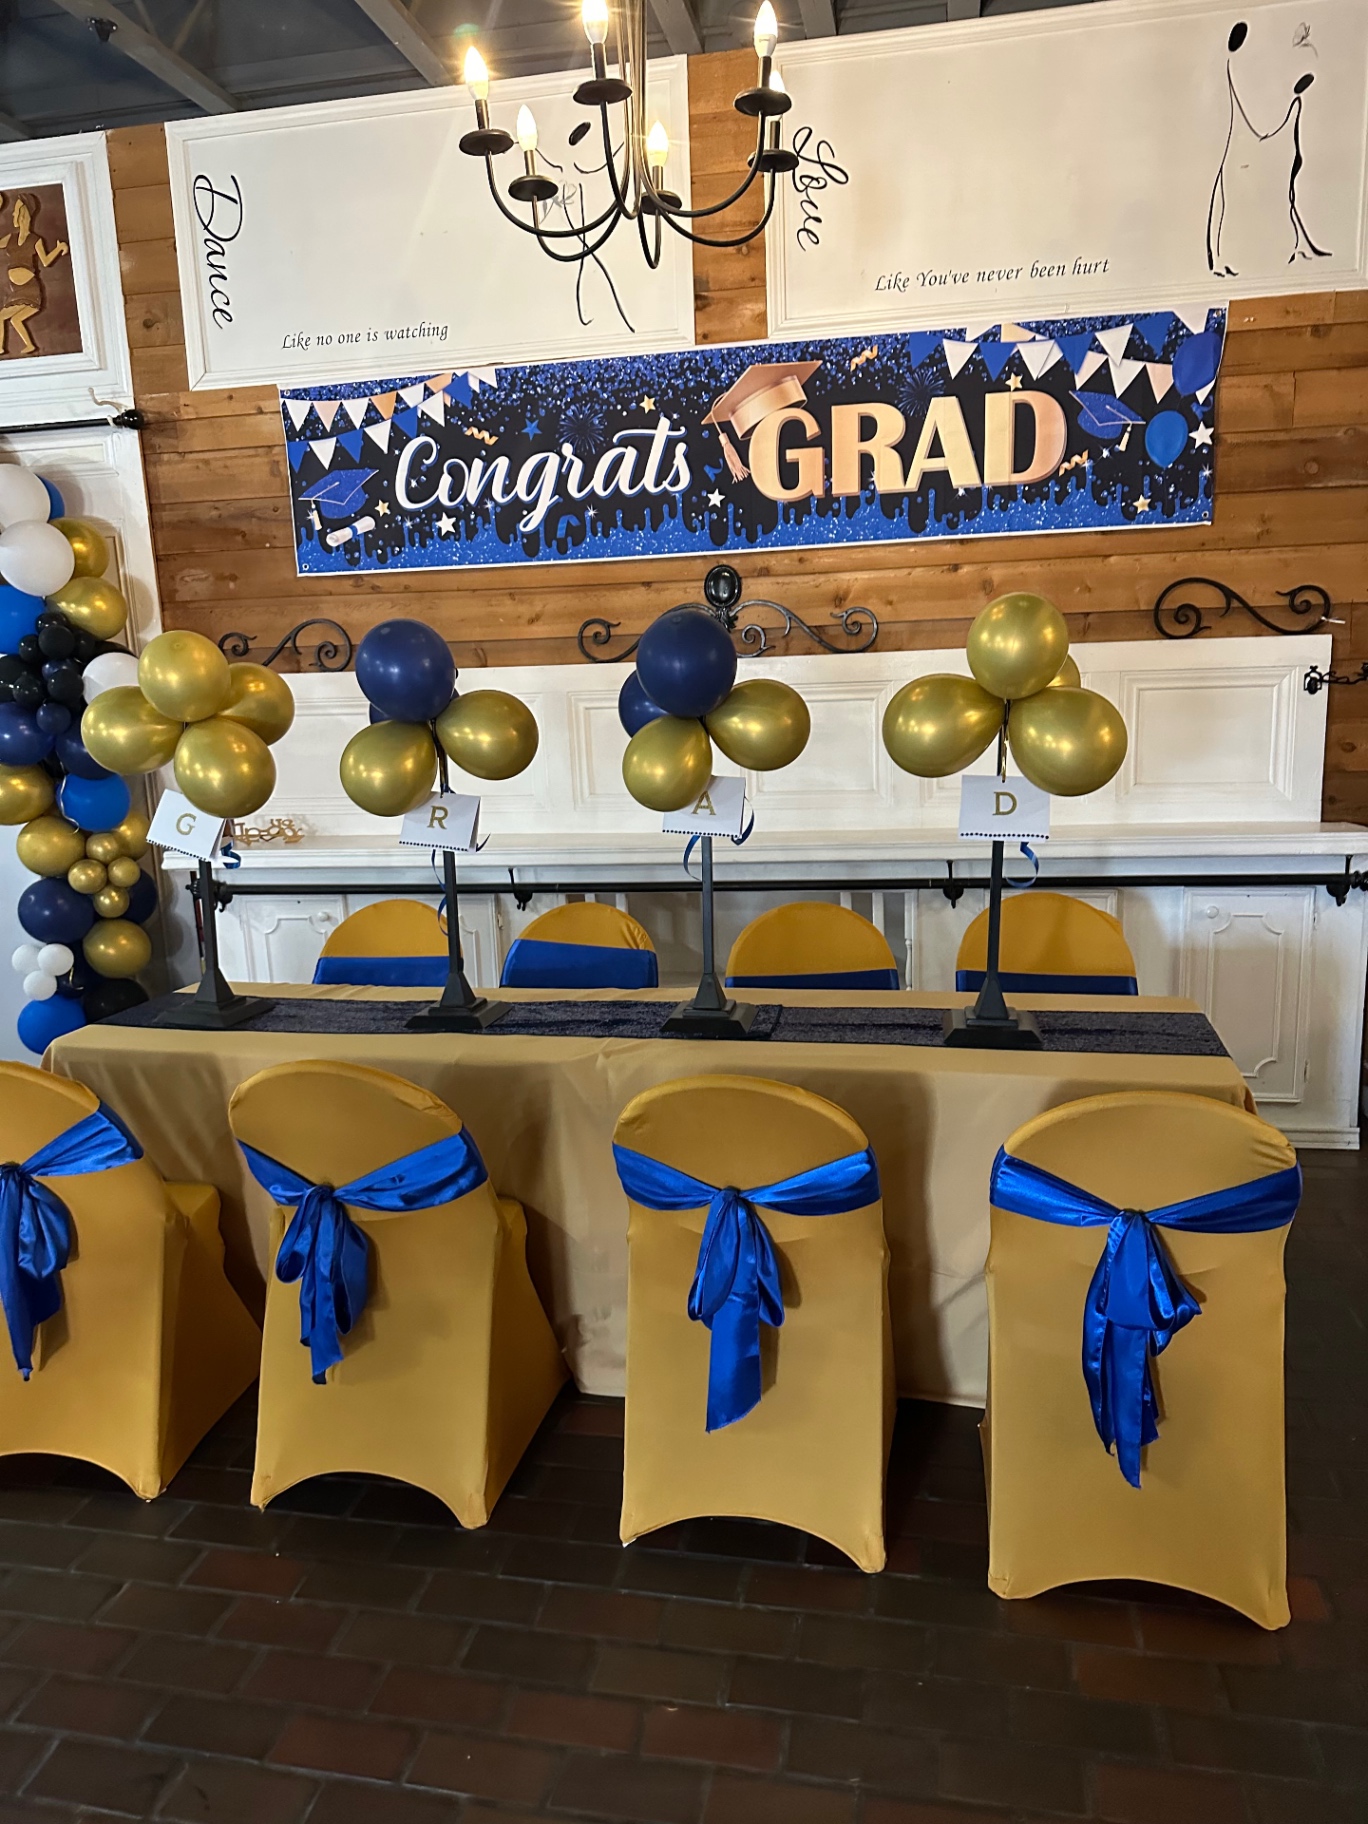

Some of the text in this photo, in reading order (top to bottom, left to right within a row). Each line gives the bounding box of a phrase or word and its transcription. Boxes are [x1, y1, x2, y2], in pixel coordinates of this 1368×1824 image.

[791, 126, 849, 252] Love
[193, 174, 243, 330] Dance
[874, 256, 1110, 293] Like You've never been hurt
[282, 321, 449, 351] Like no one is watching
[395, 390, 1068, 534] Congrats GRAD
[428, 804, 448, 831] R
[690, 790, 717, 816] A
[991, 790, 1018, 816] D
[175, 812, 198, 837] G
